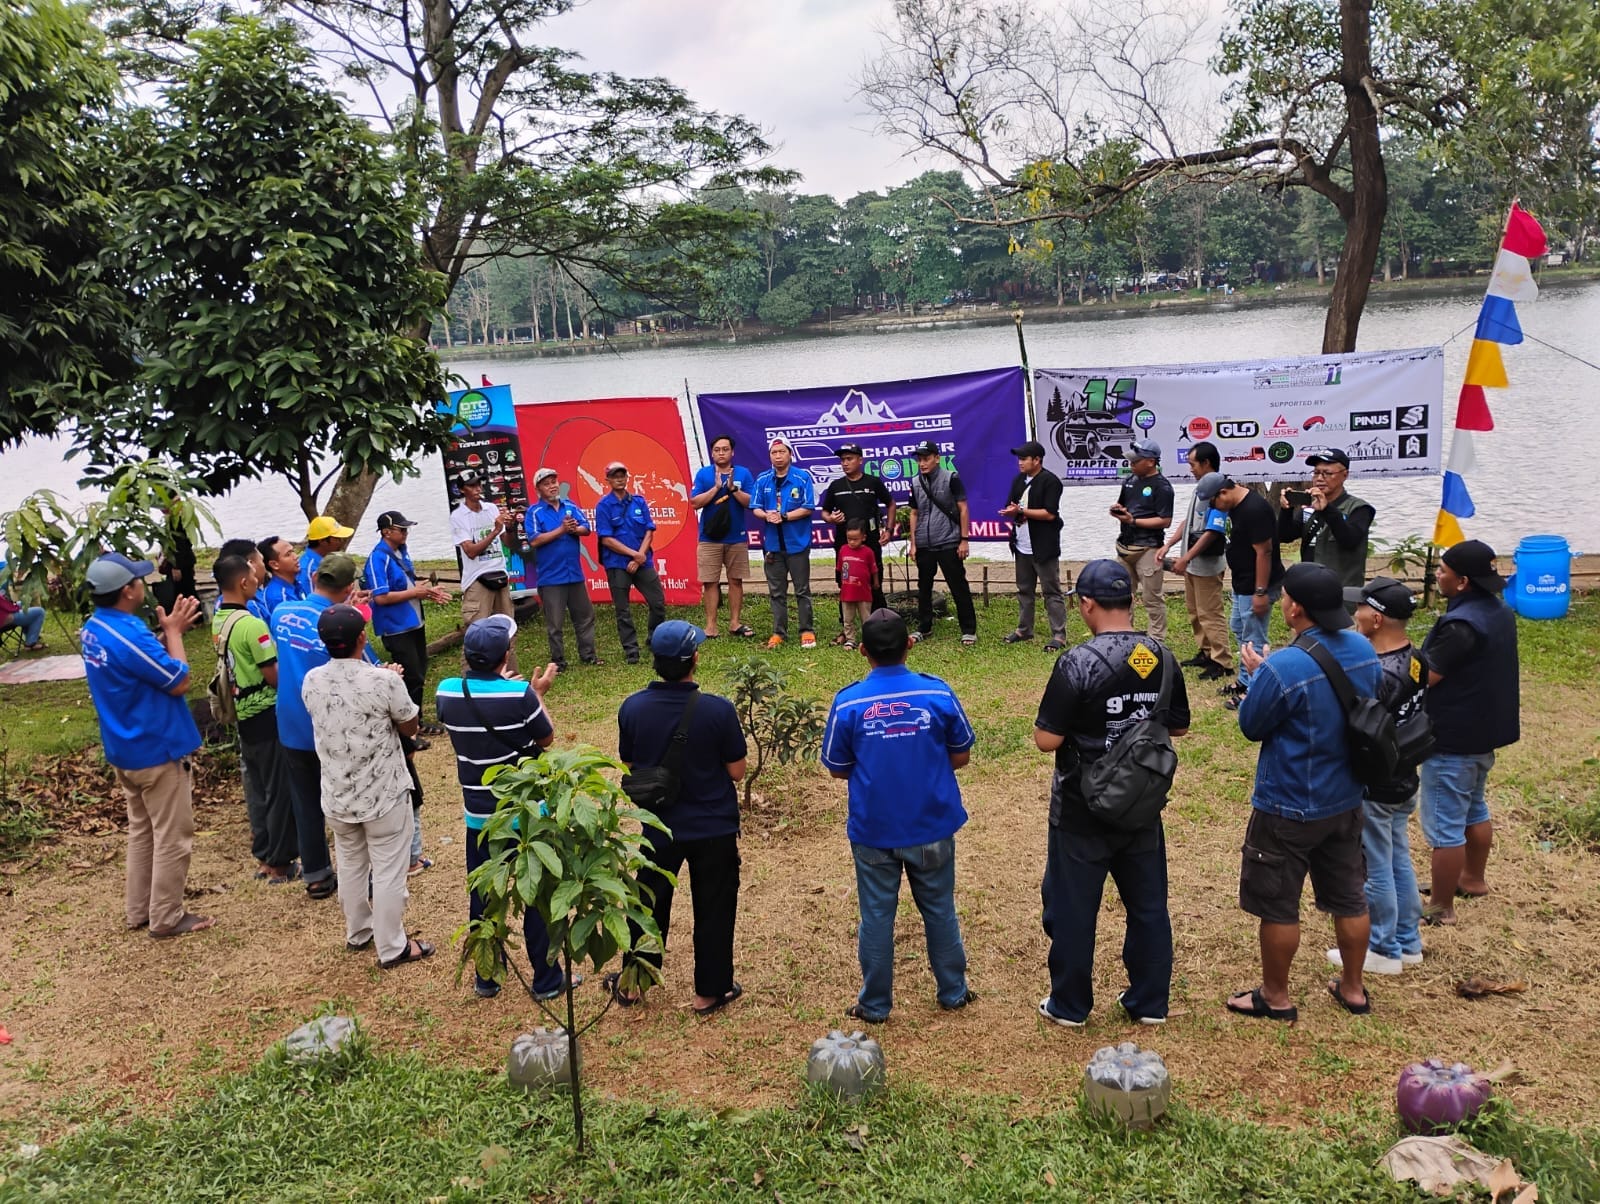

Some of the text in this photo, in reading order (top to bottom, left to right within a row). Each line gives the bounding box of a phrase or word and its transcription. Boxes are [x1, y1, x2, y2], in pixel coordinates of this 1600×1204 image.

[1270, 400, 1312, 408] SUPPORTED
[1354, 415, 1389, 426] PINUS
[766, 427, 839, 440] DAIHATSU
[914, 419, 952, 429] CLUB
[862, 442, 955, 458] CHAPR
[1067, 460, 1117, 468] CHAPTER
